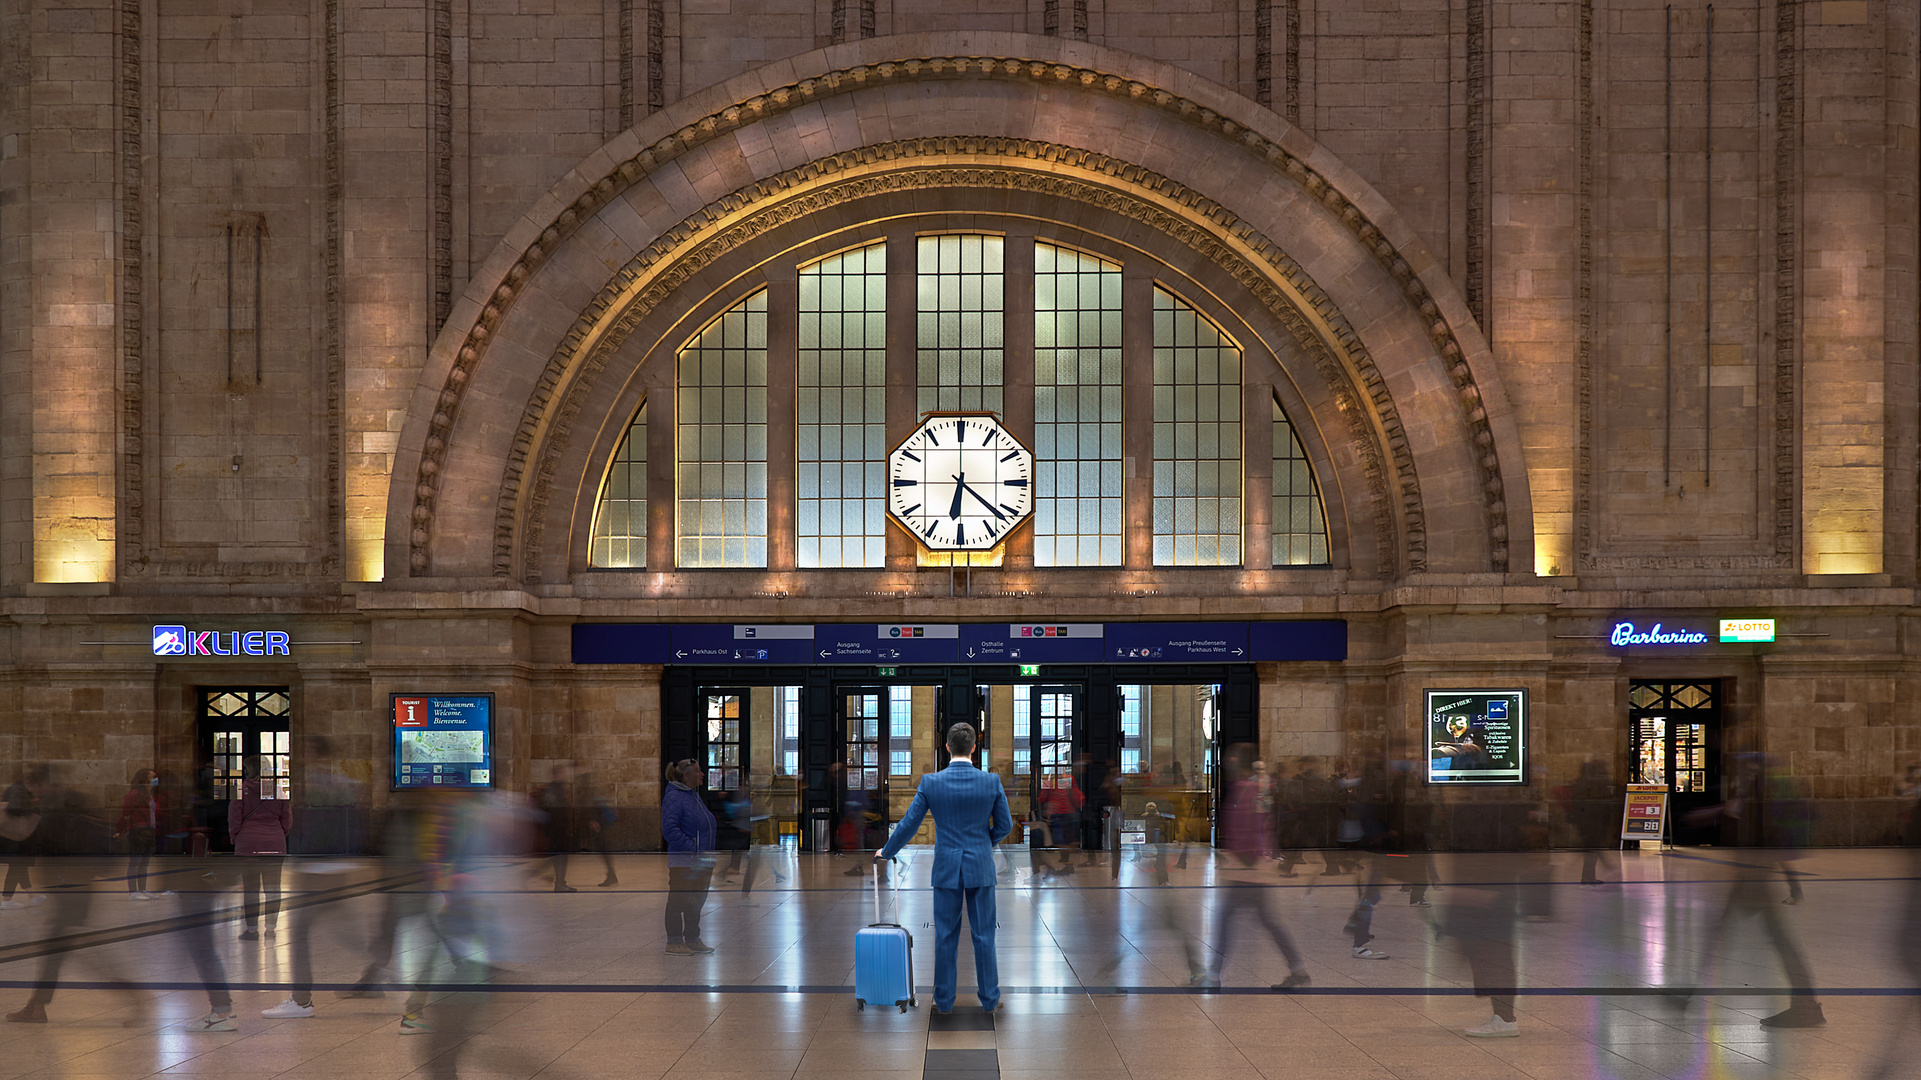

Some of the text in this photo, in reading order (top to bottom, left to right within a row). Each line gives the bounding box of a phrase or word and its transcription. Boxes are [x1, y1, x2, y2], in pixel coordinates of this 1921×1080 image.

[1738, 623, 1771, 631] LOTTO
[1610, 621, 1708, 646] Barbarino.
[188, 630, 290, 656] KLIER
[1435, 702, 1457, 713] DIREKT
[433, 717, 468, 725] Bienvenue.
